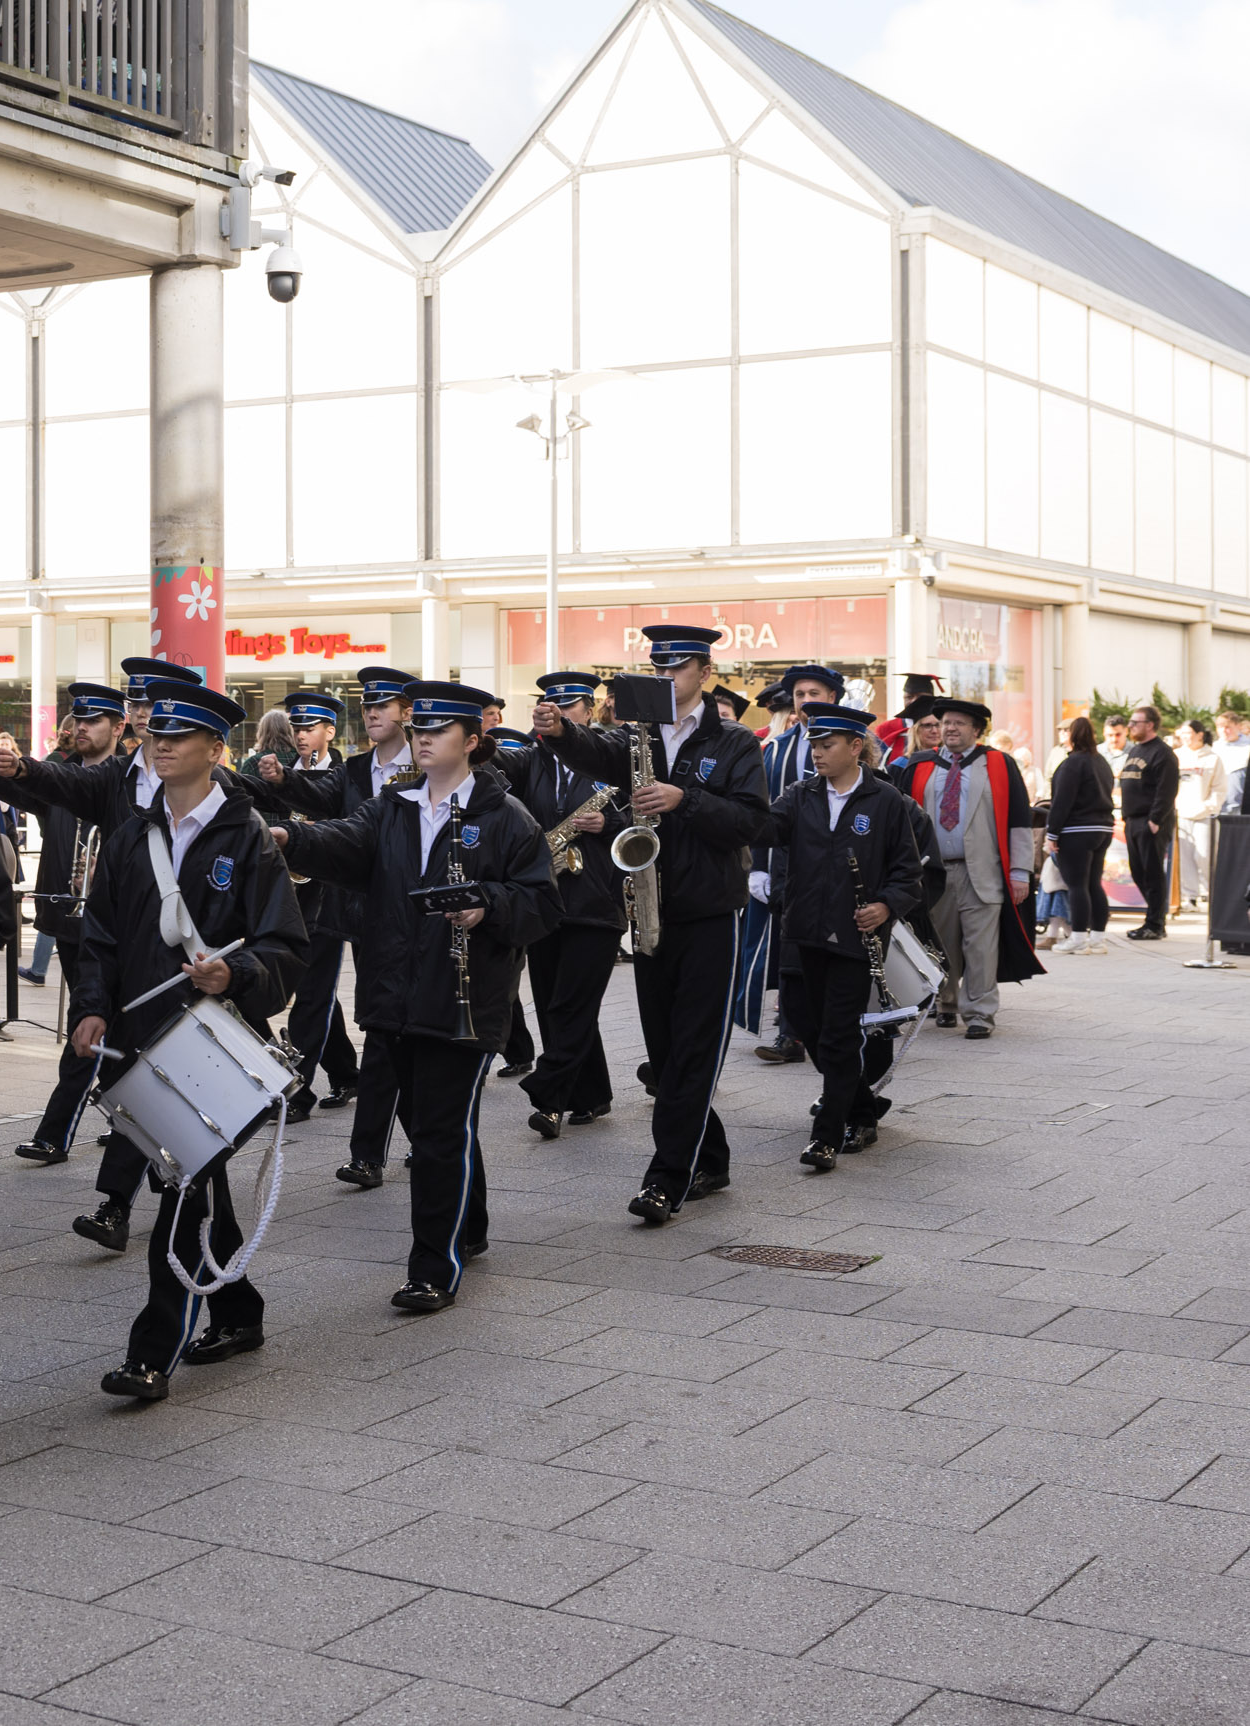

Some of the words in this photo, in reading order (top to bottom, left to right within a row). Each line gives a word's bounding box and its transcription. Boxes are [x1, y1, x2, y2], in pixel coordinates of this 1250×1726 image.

[226, 629, 286, 661] lings
[290, 627, 350, 659] Toys
[623, 623, 778, 652] PORA
